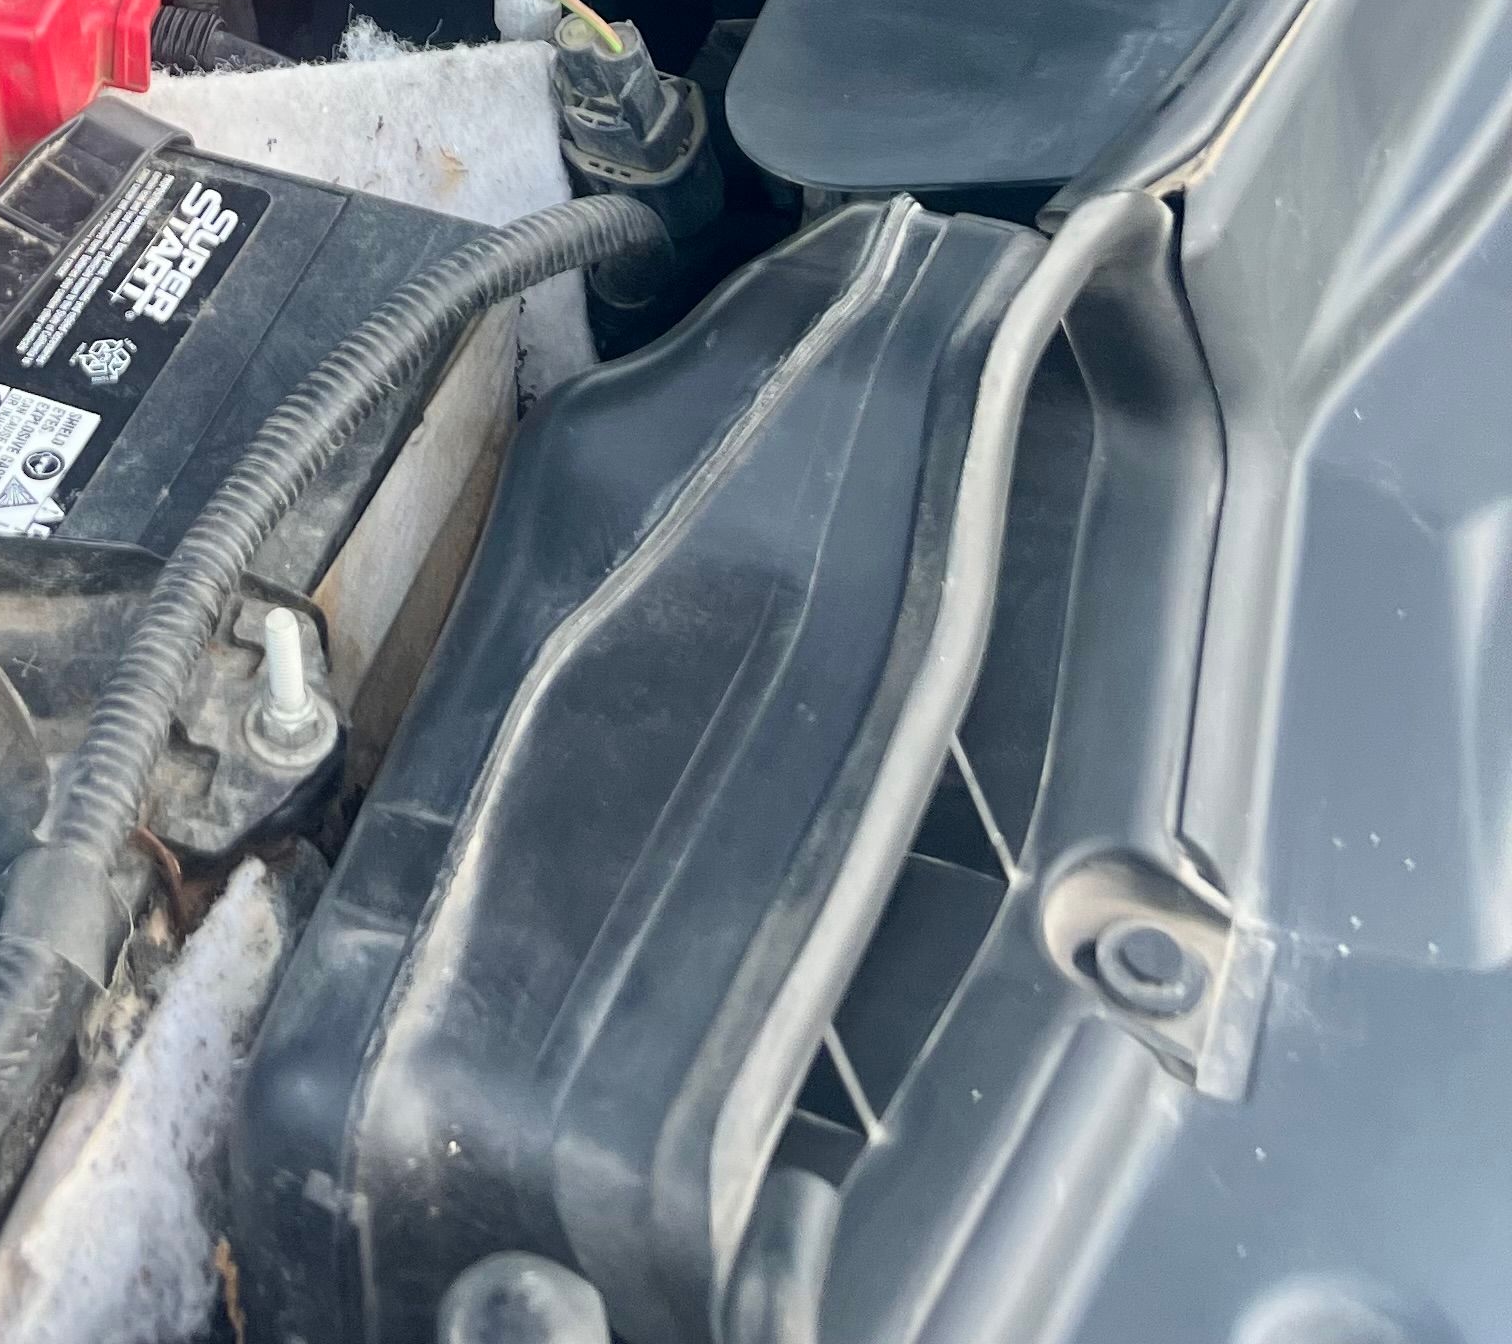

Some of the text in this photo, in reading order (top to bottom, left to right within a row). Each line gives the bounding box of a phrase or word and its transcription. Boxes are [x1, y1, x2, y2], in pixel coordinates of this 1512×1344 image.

[120, 179, 223, 317] START
[141, 203, 241, 325] SUPER
[4, 392, 21, 407] OR
[14, 397, 33, 415] CAN
[5, 400, 49, 454] EXPLOSIVE
[50, 410, 82, 448] SHIELD
